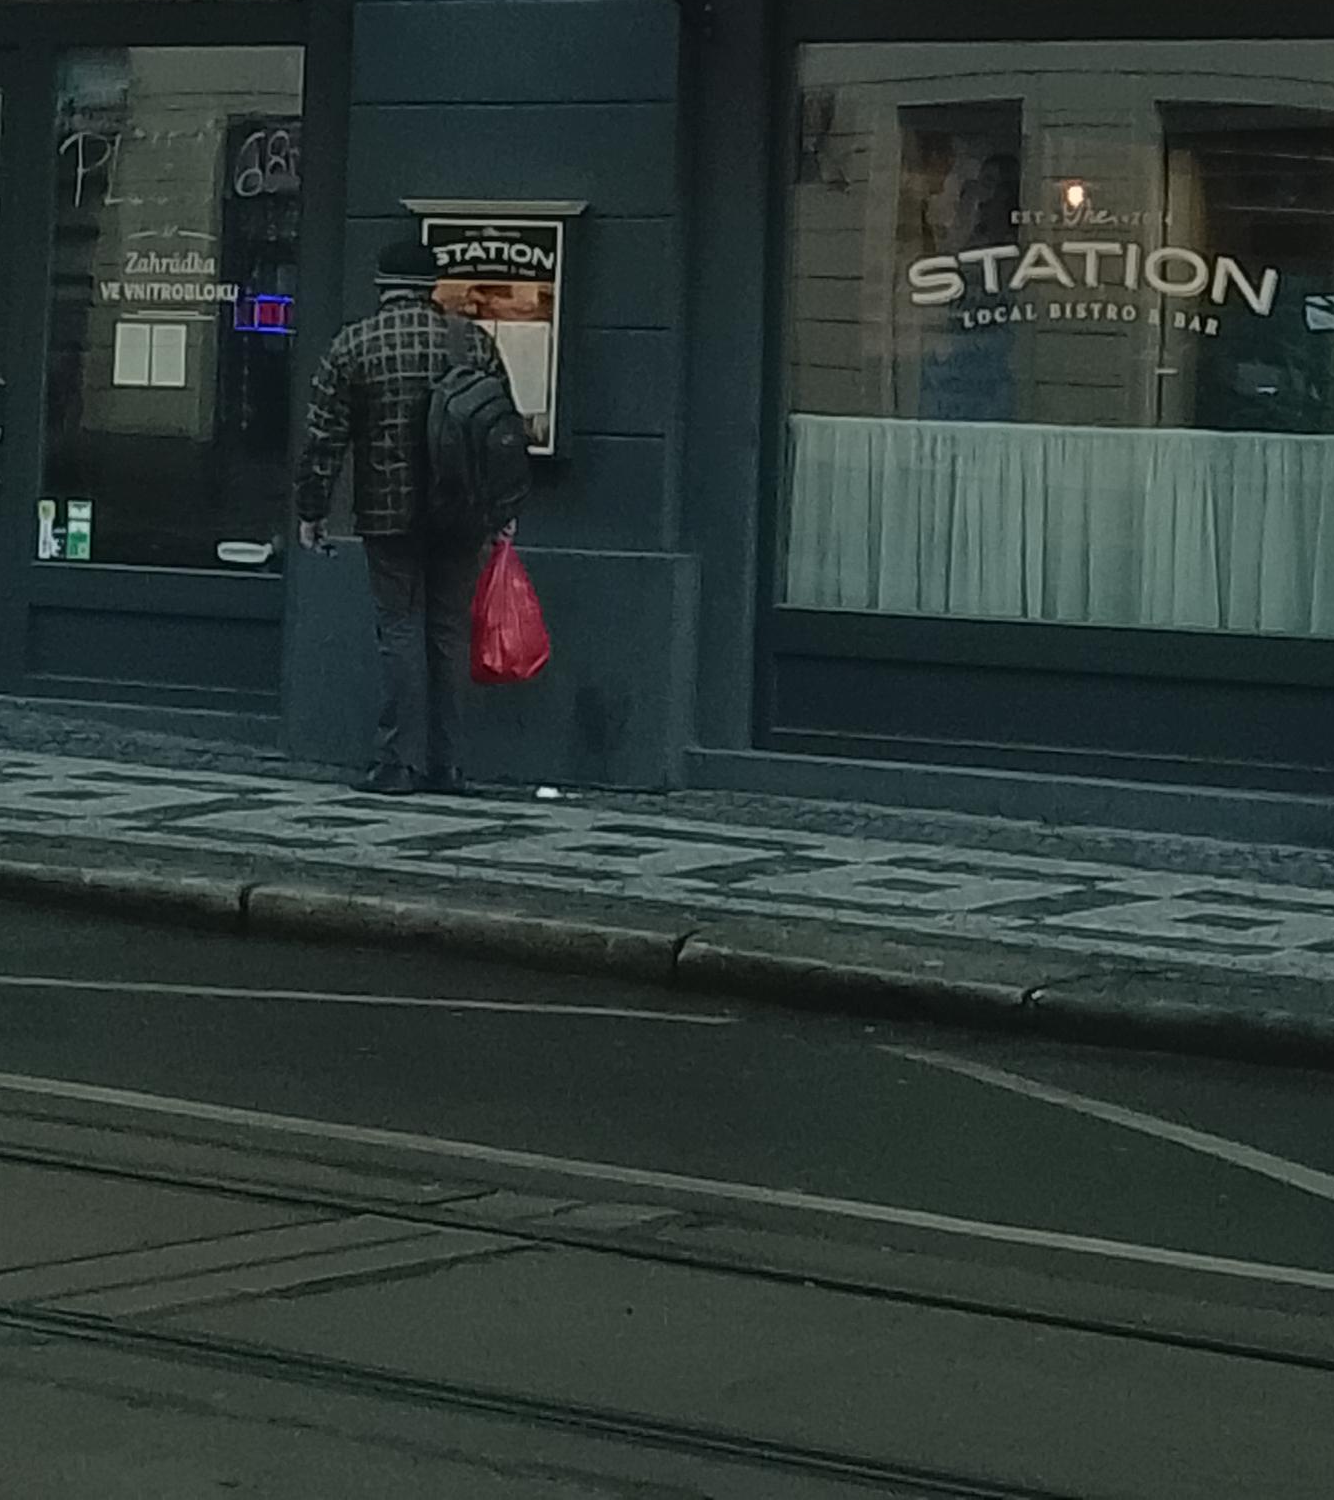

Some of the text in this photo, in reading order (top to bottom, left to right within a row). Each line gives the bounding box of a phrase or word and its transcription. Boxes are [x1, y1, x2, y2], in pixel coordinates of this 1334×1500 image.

[431, 241, 555, 270] STATION
[908, 240, 1279, 316] STATION
[962, 303, 1037, 328] LOCAL
[1049, 302, 1137, 321] BISTRO
[1173, 312, 1219, 336] BAR
